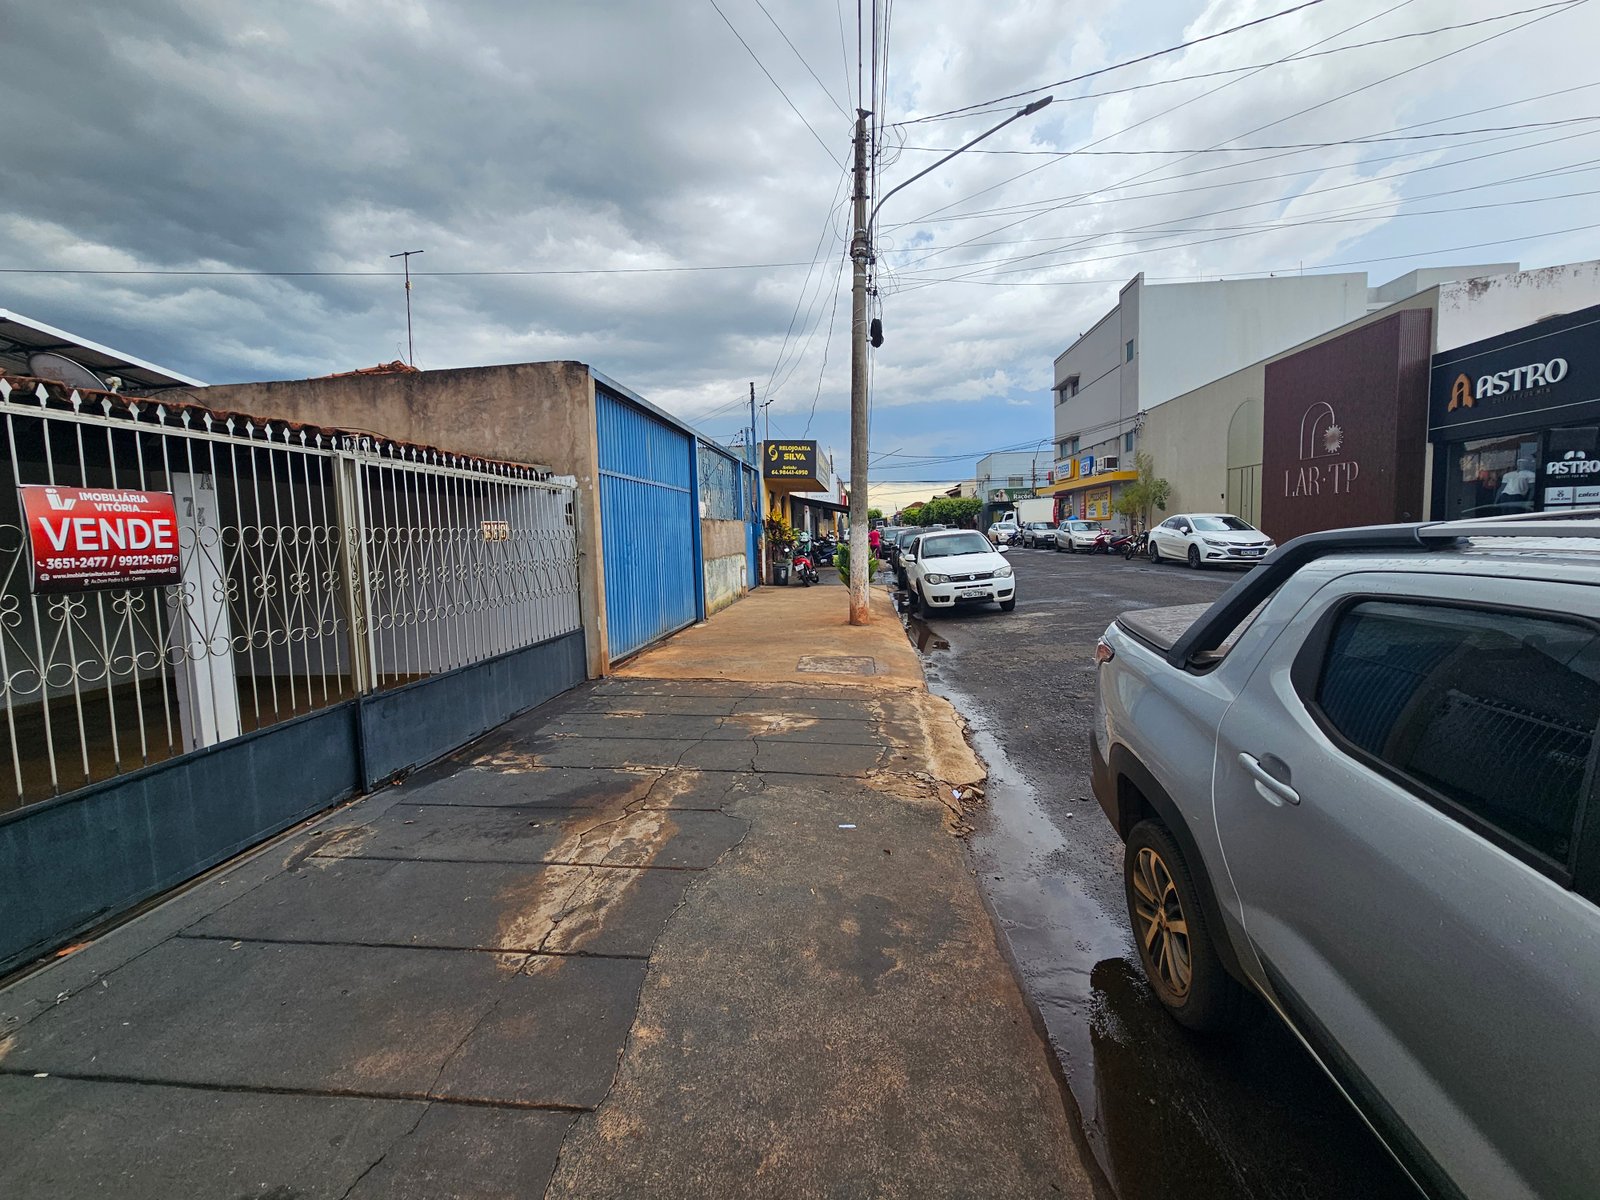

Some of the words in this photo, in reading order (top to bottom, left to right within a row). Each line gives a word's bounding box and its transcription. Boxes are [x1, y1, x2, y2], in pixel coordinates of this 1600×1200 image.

[1476, 357, 1569, 400] ASTRO
[778, 445, 812, 453] RELOJOARIA
[783, 453, 806, 461] SILVA
[1546, 460, 1600, 475] ASTRO
[79, 492, 149, 503] IMOBILIÁRIA
[94, 502, 140, 513] VITÓRIA
[38, 516, 173, 551] VENDE
[46, 556, 108, 569] 3651-2477
[119, 554, 172, 566] 99212-1677
